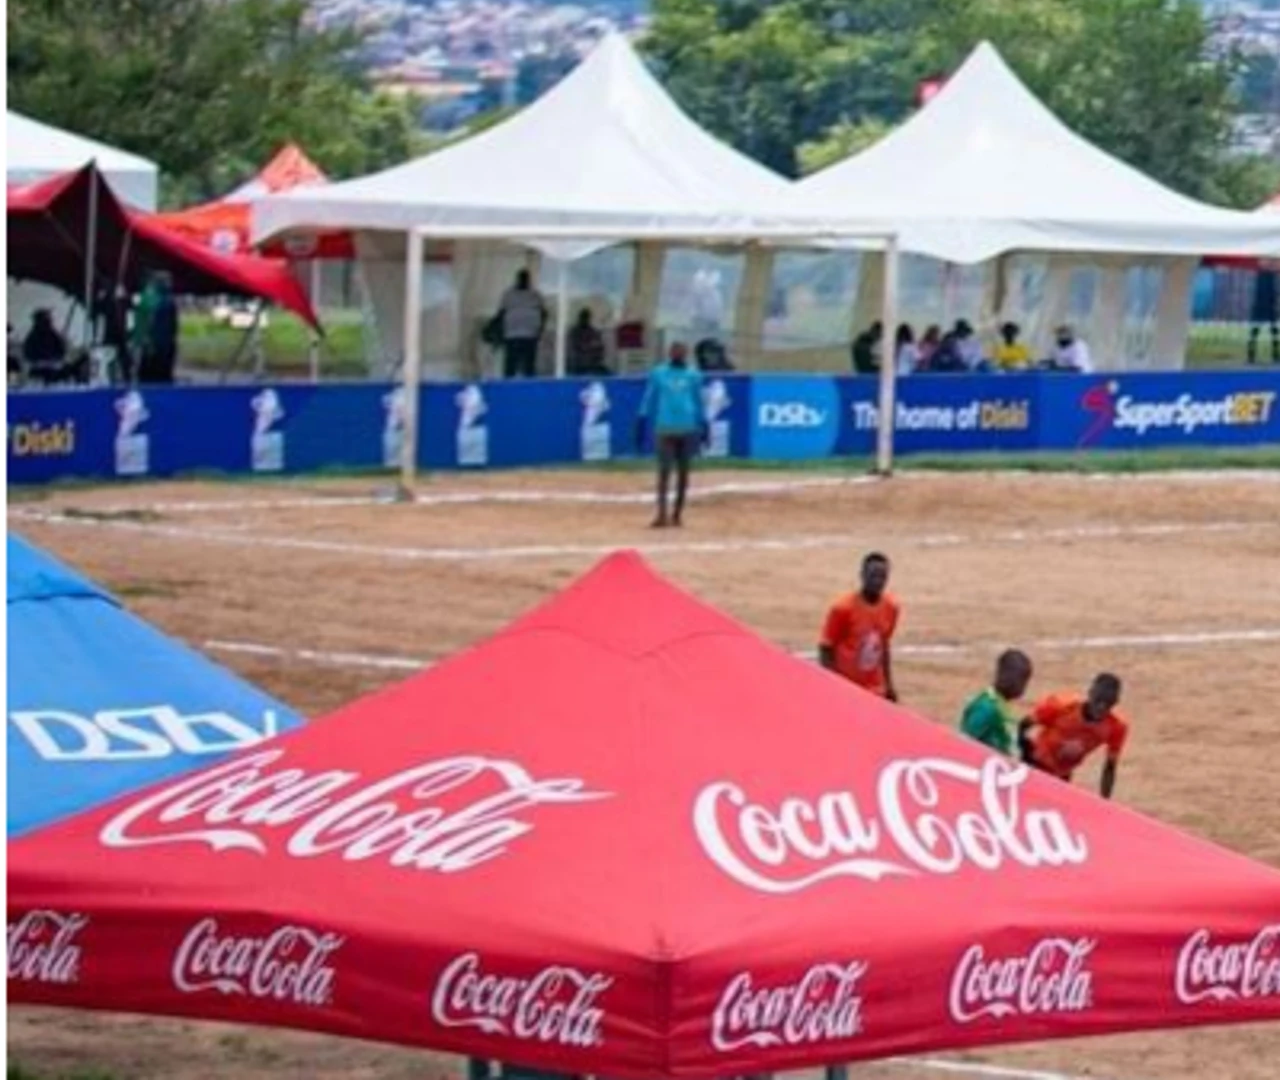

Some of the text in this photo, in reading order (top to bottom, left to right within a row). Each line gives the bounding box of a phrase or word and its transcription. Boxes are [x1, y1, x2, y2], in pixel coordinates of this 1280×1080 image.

[852, 402, 878, 430] Th
[896, 402, 951, 430] home
[956, 401, 980, 430] of
[12, 420, 75, 456] Diski
[8, 704, 277, 761] DStv
